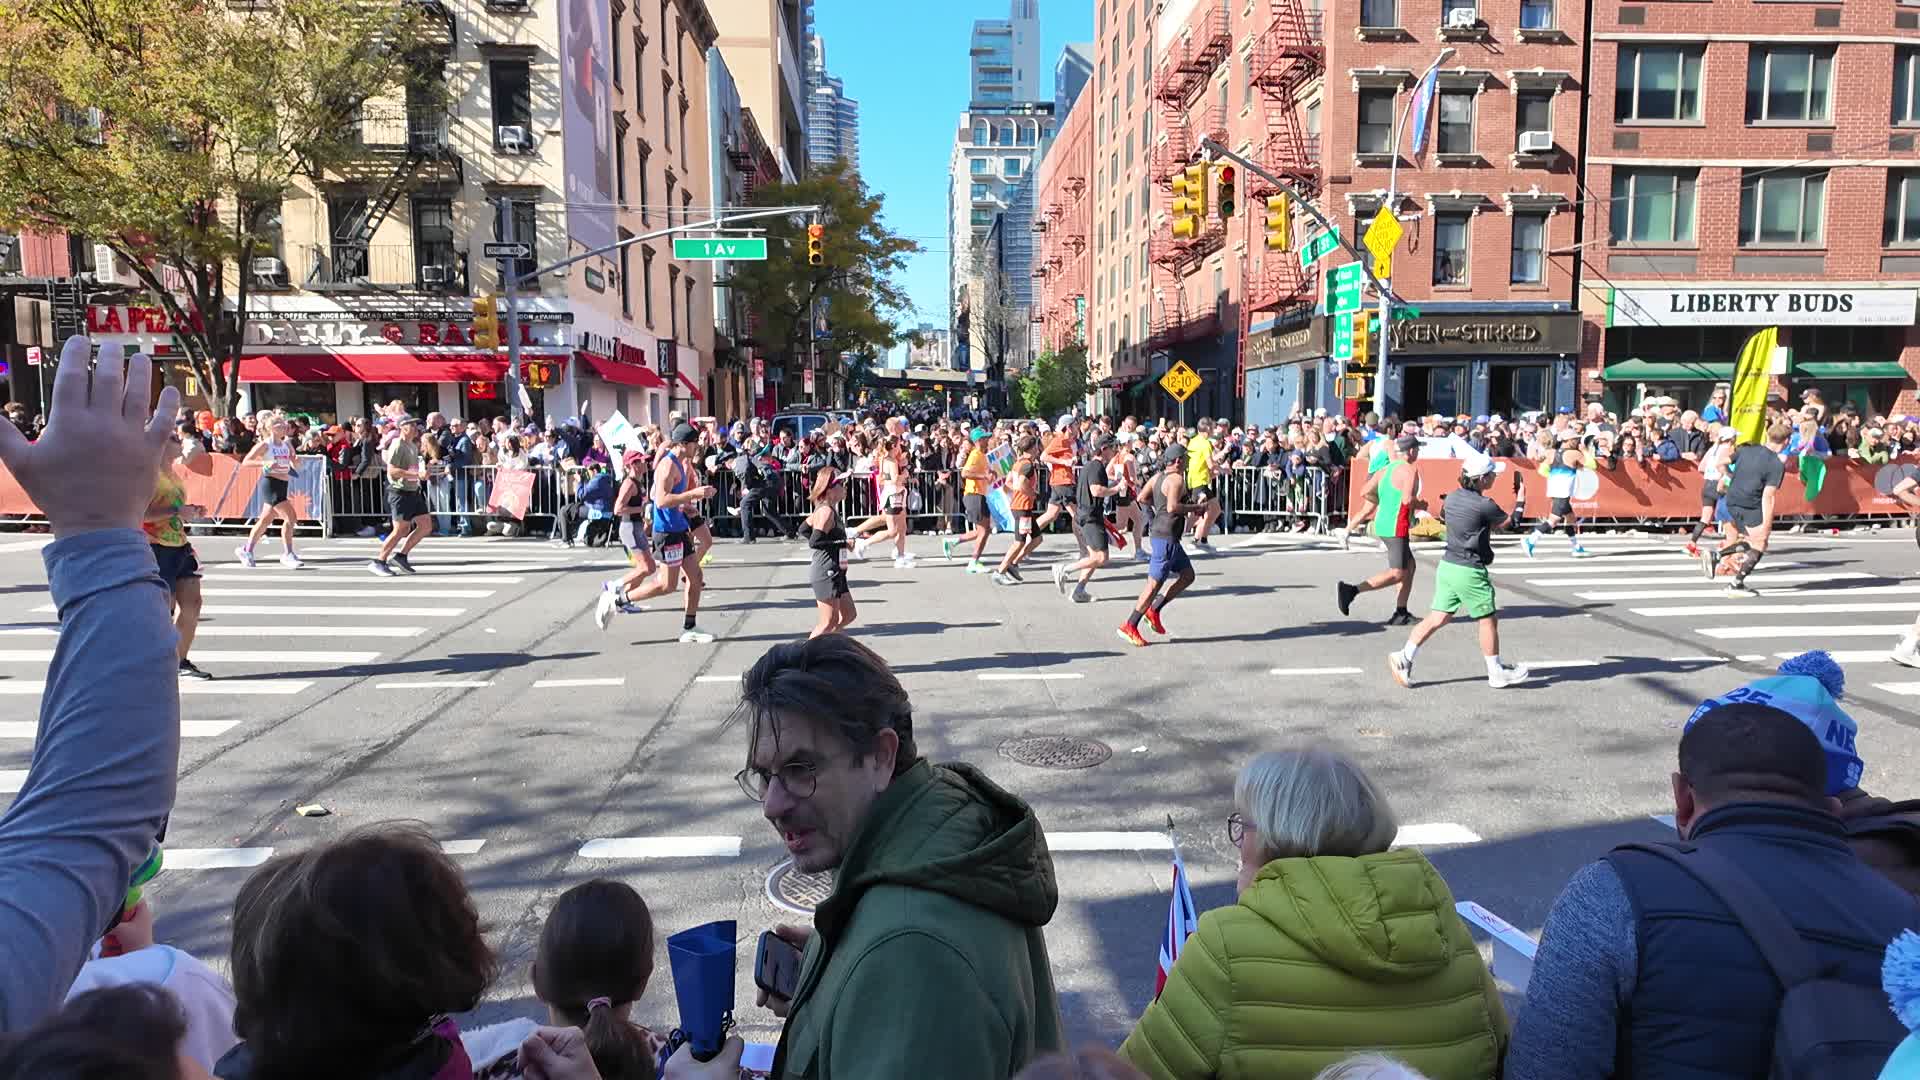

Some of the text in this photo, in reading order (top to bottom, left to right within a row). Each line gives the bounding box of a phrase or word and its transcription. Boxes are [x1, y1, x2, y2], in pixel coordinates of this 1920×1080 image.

[704, 242, 736, 256] 1 Av
[1670, 293, 1854, 313] LIBERTY BUDS
[87, 304, 123, 333] LA
[252, 323, 368, 346] DAILY
[1461, 323, 1538, 341] STIRRED
[1167, 375, 1192, 387] 12-10
